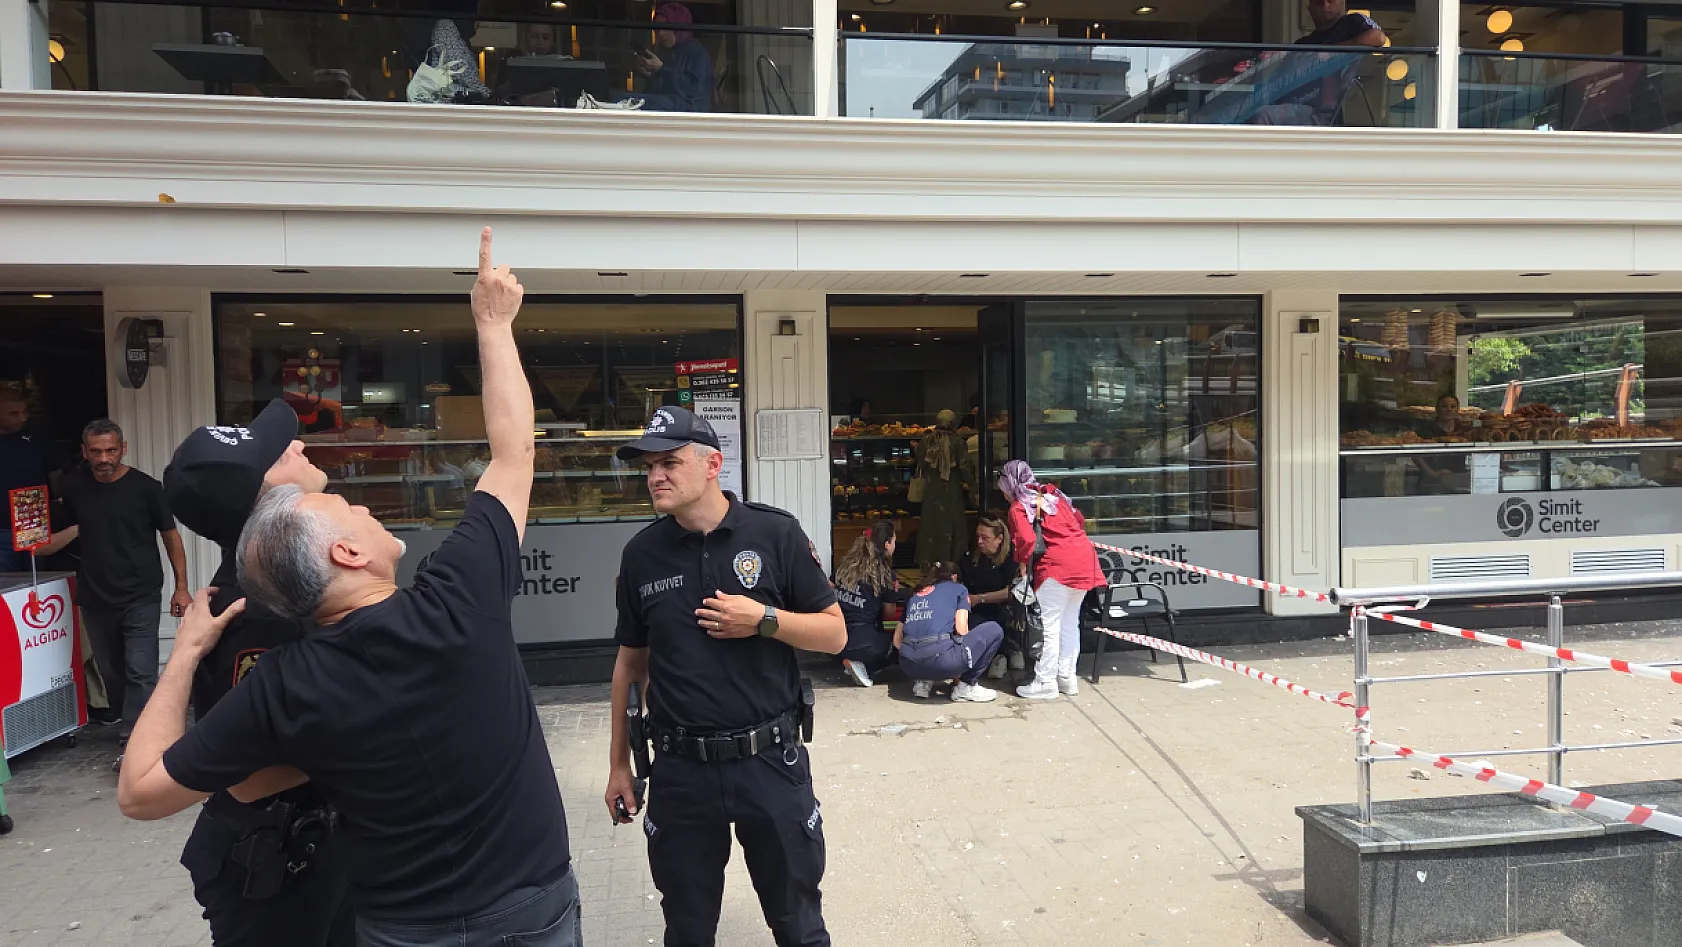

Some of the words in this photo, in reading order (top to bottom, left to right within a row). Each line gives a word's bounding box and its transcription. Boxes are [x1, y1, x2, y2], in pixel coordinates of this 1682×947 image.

[1538, 498, 1584, 516] Simit
[1538, 517, 1600, 534] Center
[1130, 543, 1187, 566] Simit
[515, 573, 580, 596] nter
[654, 574, 684, 593] KUVVET
